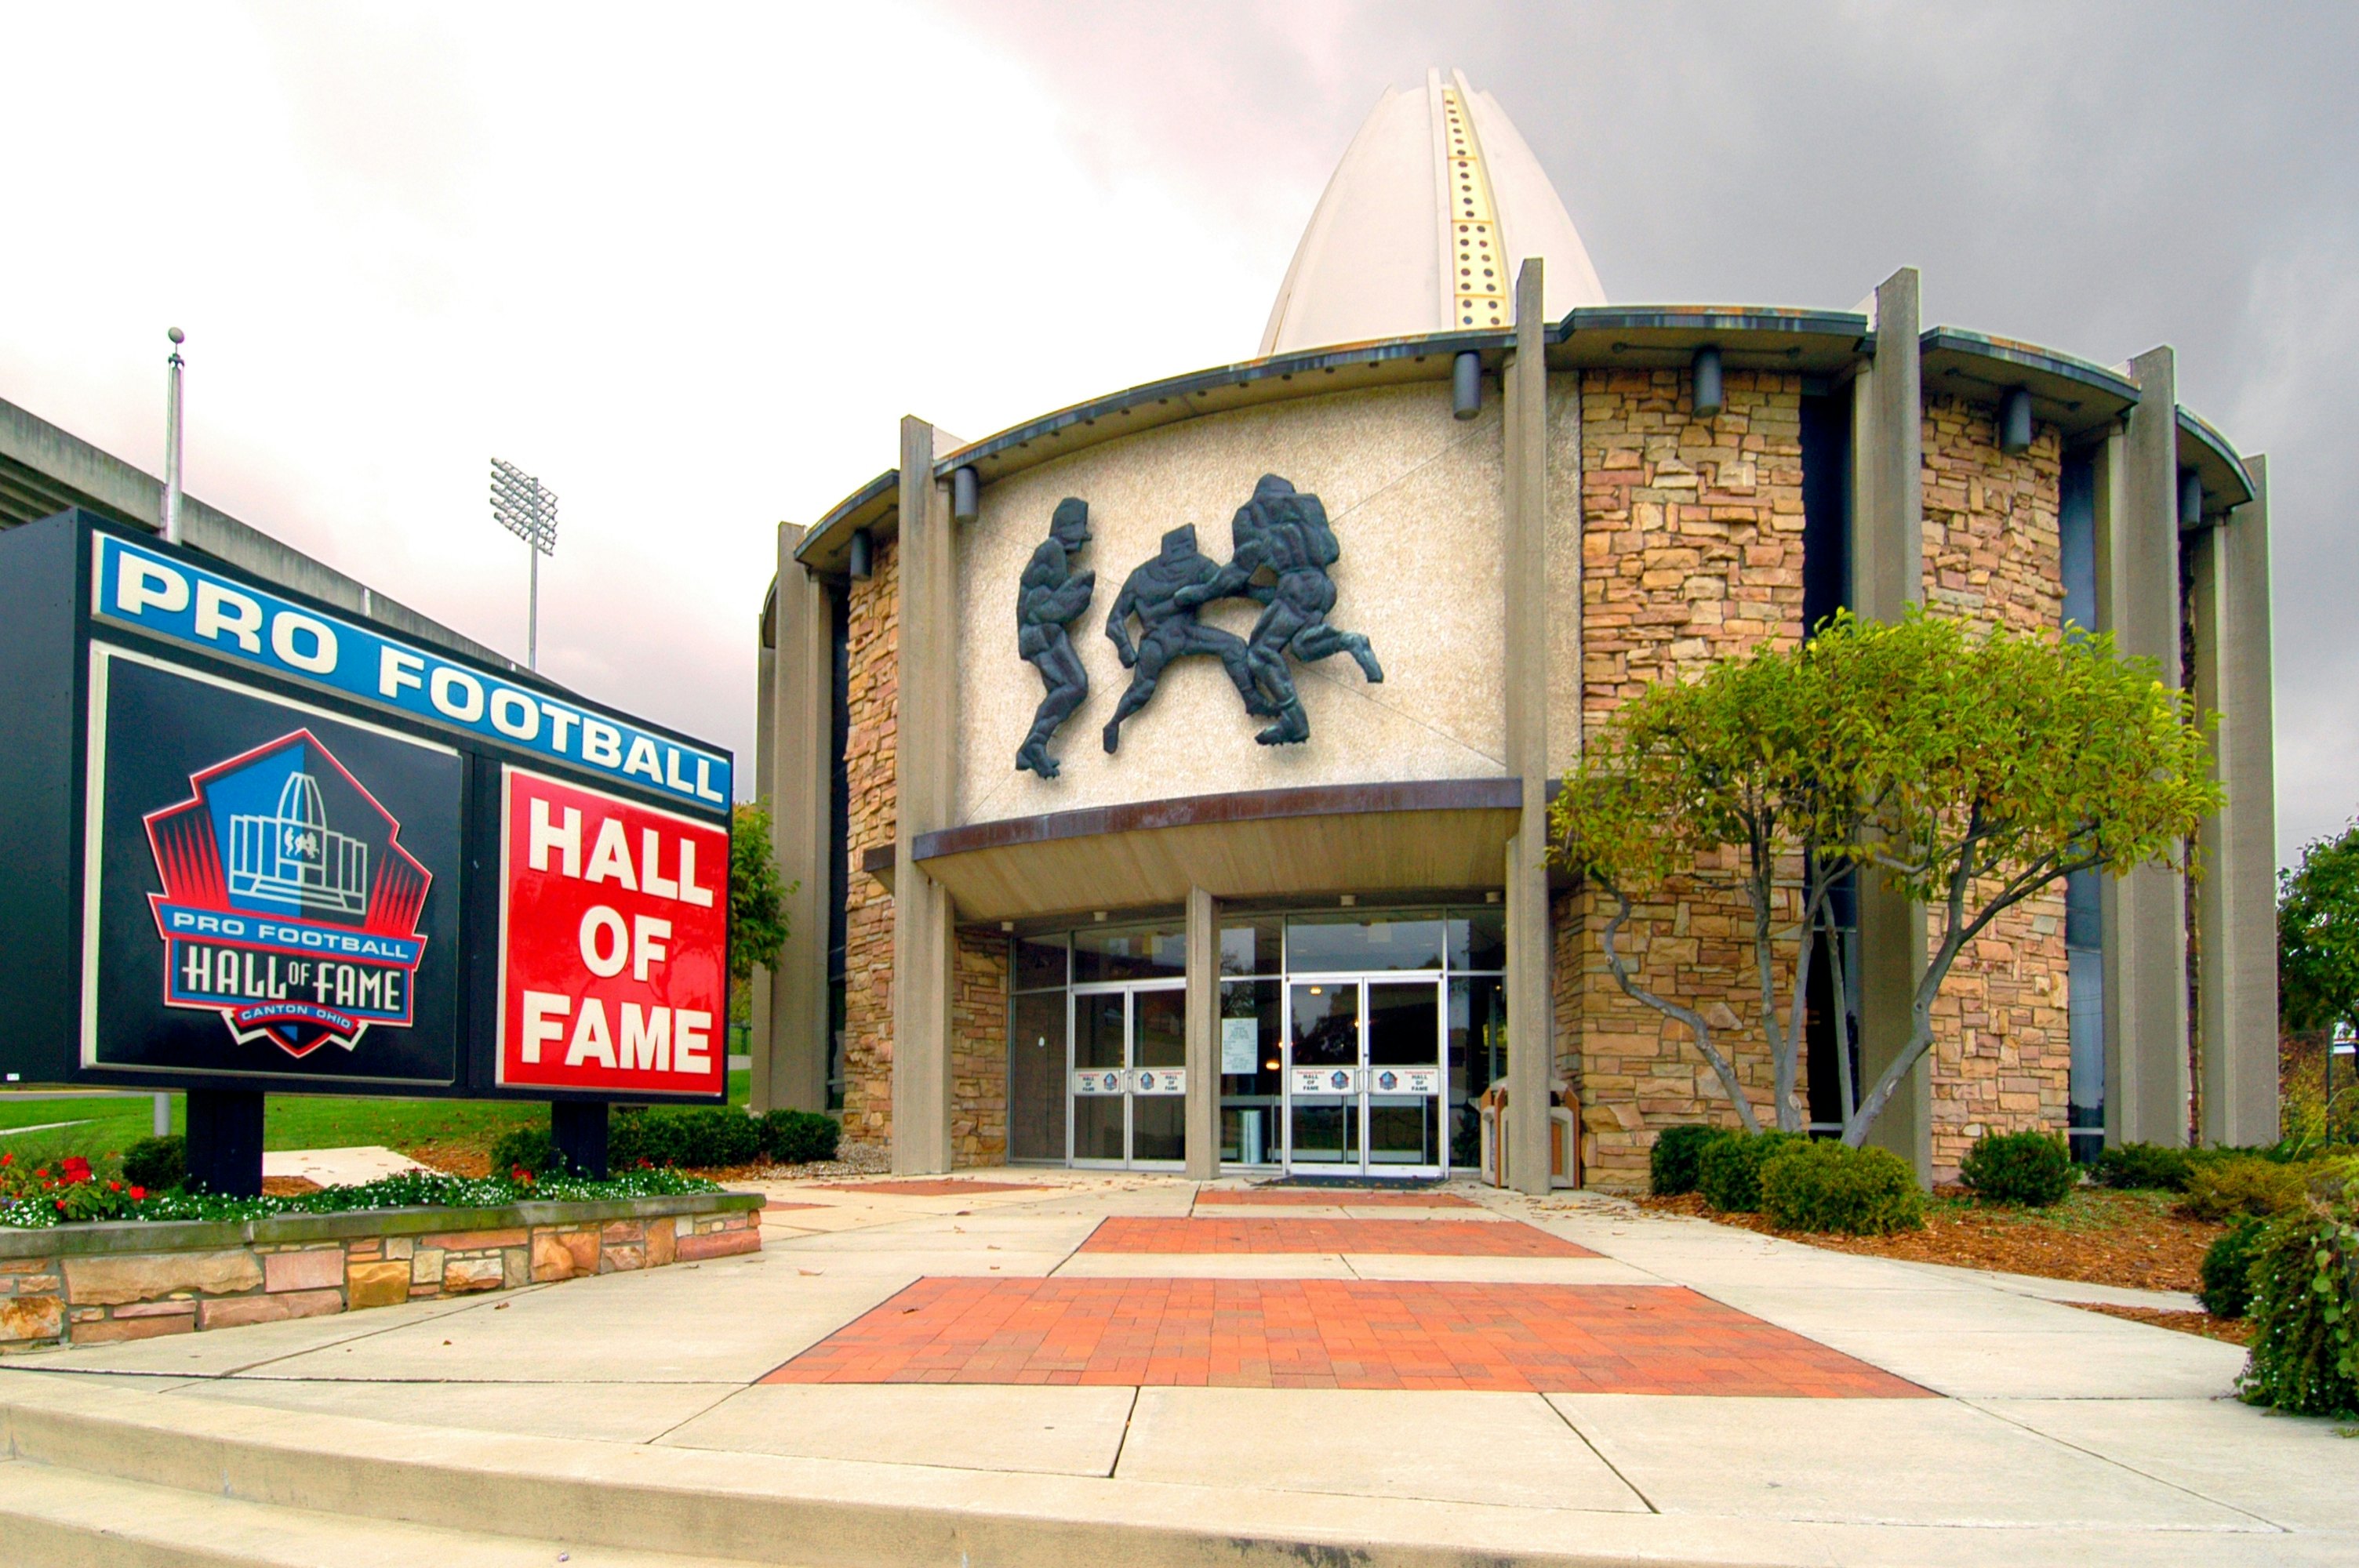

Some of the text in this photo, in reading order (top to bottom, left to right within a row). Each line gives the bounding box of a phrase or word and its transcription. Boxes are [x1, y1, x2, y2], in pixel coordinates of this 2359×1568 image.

[117, 550, 724, 804] PRO FOOTBALL
[528, 797, 714, 909] HALL
[173, 912, 409, 959] PRO FOOTBALL
[579, 905, 672, 982] OF
[181, 945, 402, 1011] HALL OF FAME
[241, 1004, 352, 1029] CANTON OHIO
[522, 990, 713, 1075] FAME
